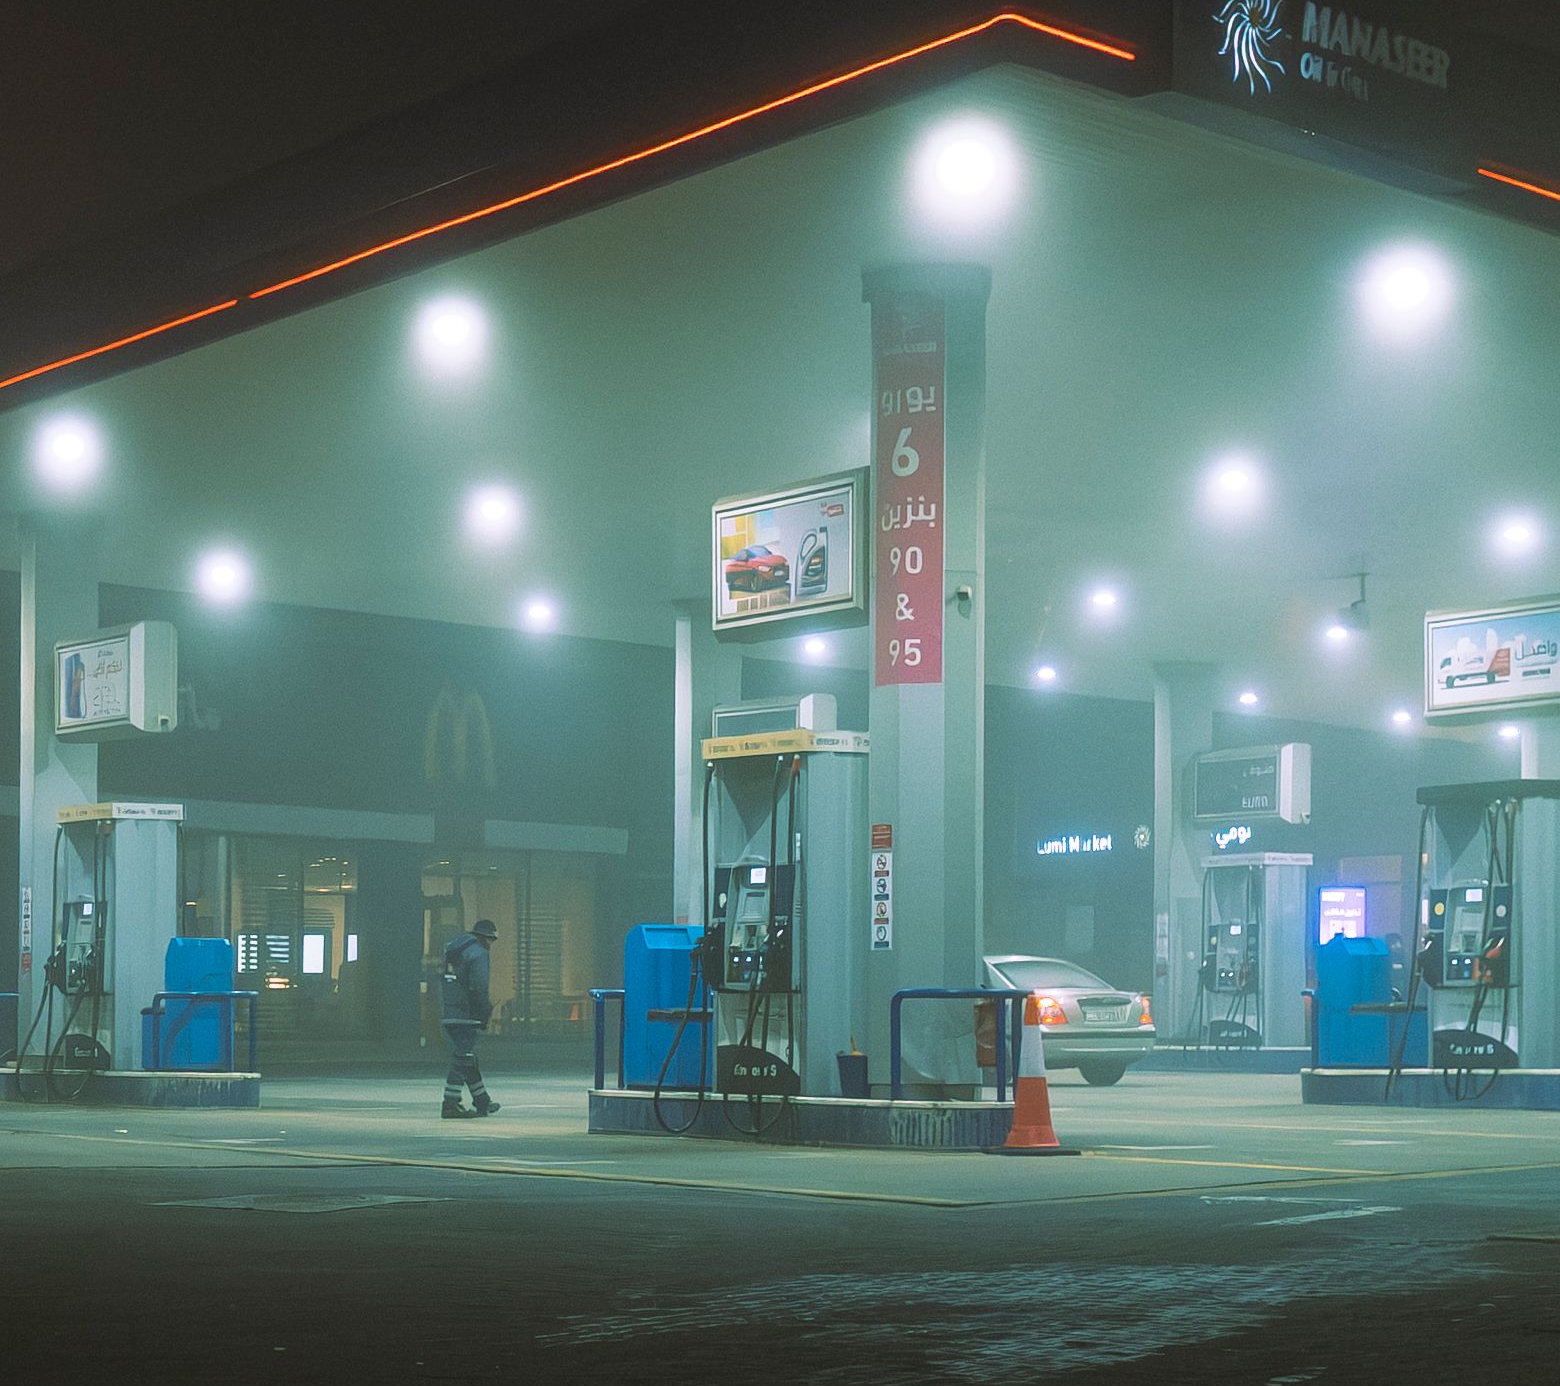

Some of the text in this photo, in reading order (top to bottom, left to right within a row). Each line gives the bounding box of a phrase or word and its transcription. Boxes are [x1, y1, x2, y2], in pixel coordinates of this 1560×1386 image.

[891, 427, 920, 477] 6
[890, 546, 923, 575] 90
[895, 593, 915, 621] &
[889, 638, 922, 667] 95
